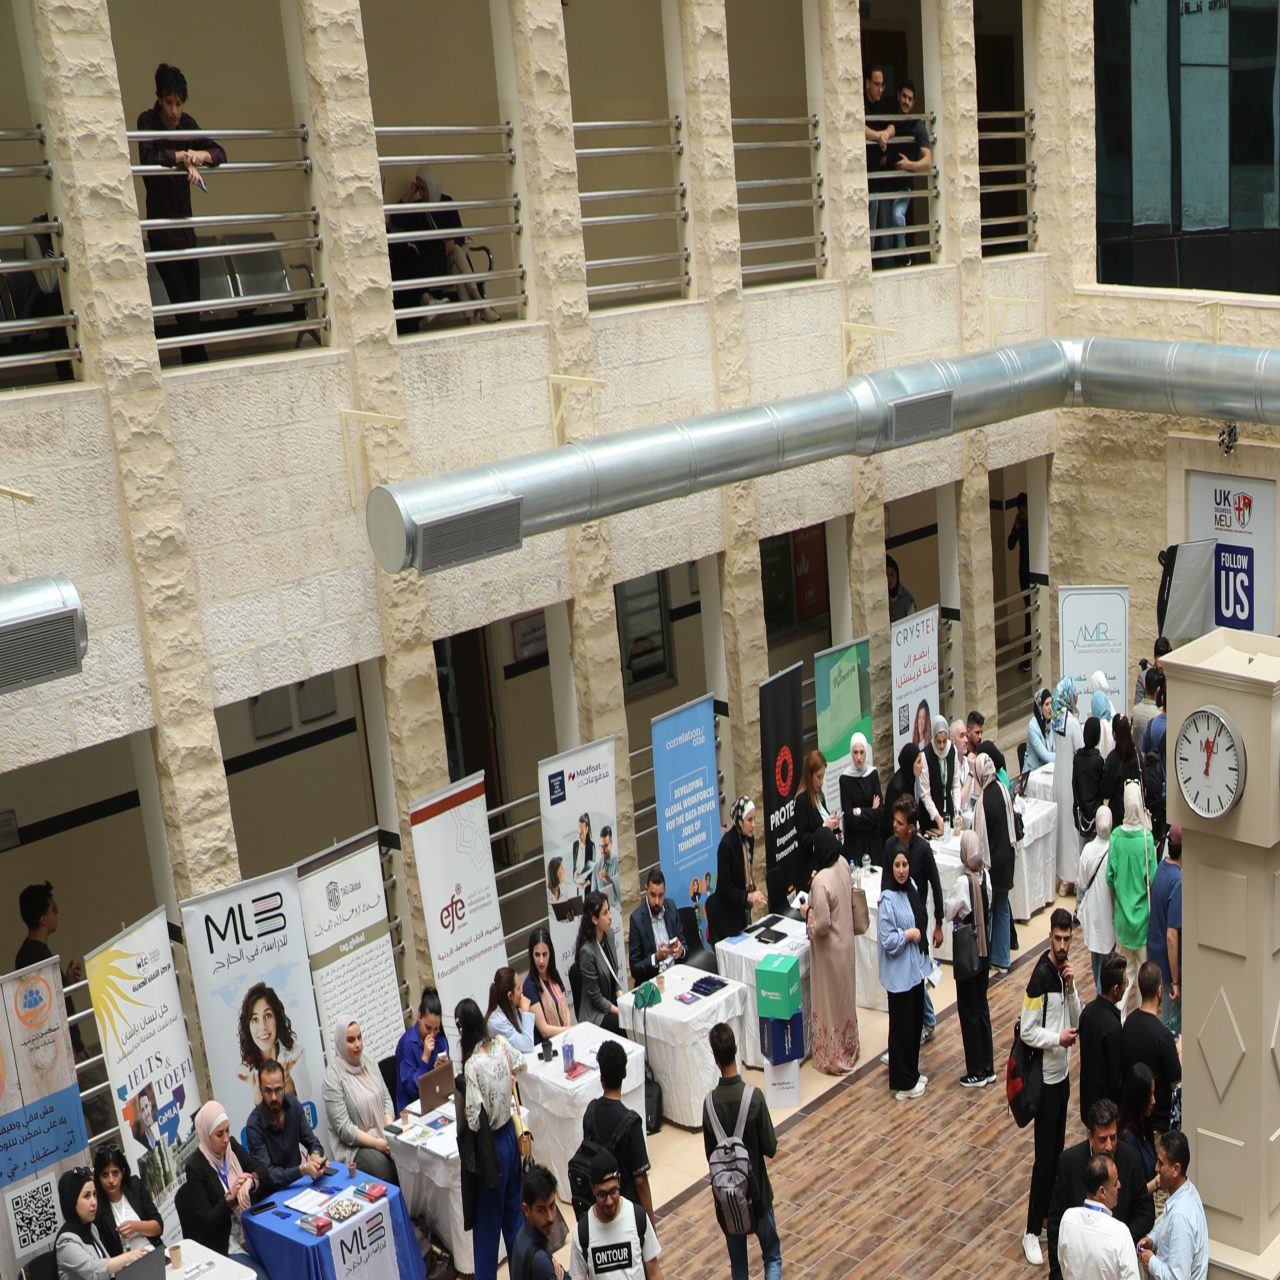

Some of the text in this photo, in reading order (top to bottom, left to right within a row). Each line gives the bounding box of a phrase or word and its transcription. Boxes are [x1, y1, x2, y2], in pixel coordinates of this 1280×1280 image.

[1214, 488, 1231, 507] UK
[1215, 514, 1232, 528] MEU
[1221, 552, 1249, 570] FOLLOW
[1220, 570, 1249, 621] US
[896, 616, 934, 647] CRYSTEL
[1200, 739, 1219, 755] MU
[674, 777, 704, 799] DEVELOPING
[664, 786, 715, 819] GLOBAL WORKFORCES
[665, 818, 675, 833] FOR
[674, 815, 685, 828] THE
[770, 800, 795, 831] PROTE
[681, 821, 701, 838] JOBS OF
[678, 832, 707, 853] TOMORROW
[440, 894, 466, 935] efe
[246, 944, 259, 964] في
[437, 962, 459, 979] Education
[128, 1051, 172, 1091] IELTS &
[158, 1103, 178, 1126] CaMLA
[0, 1121, 20, 1136] وظيف
[595, 1248, 629, 1265] ONTOUR
